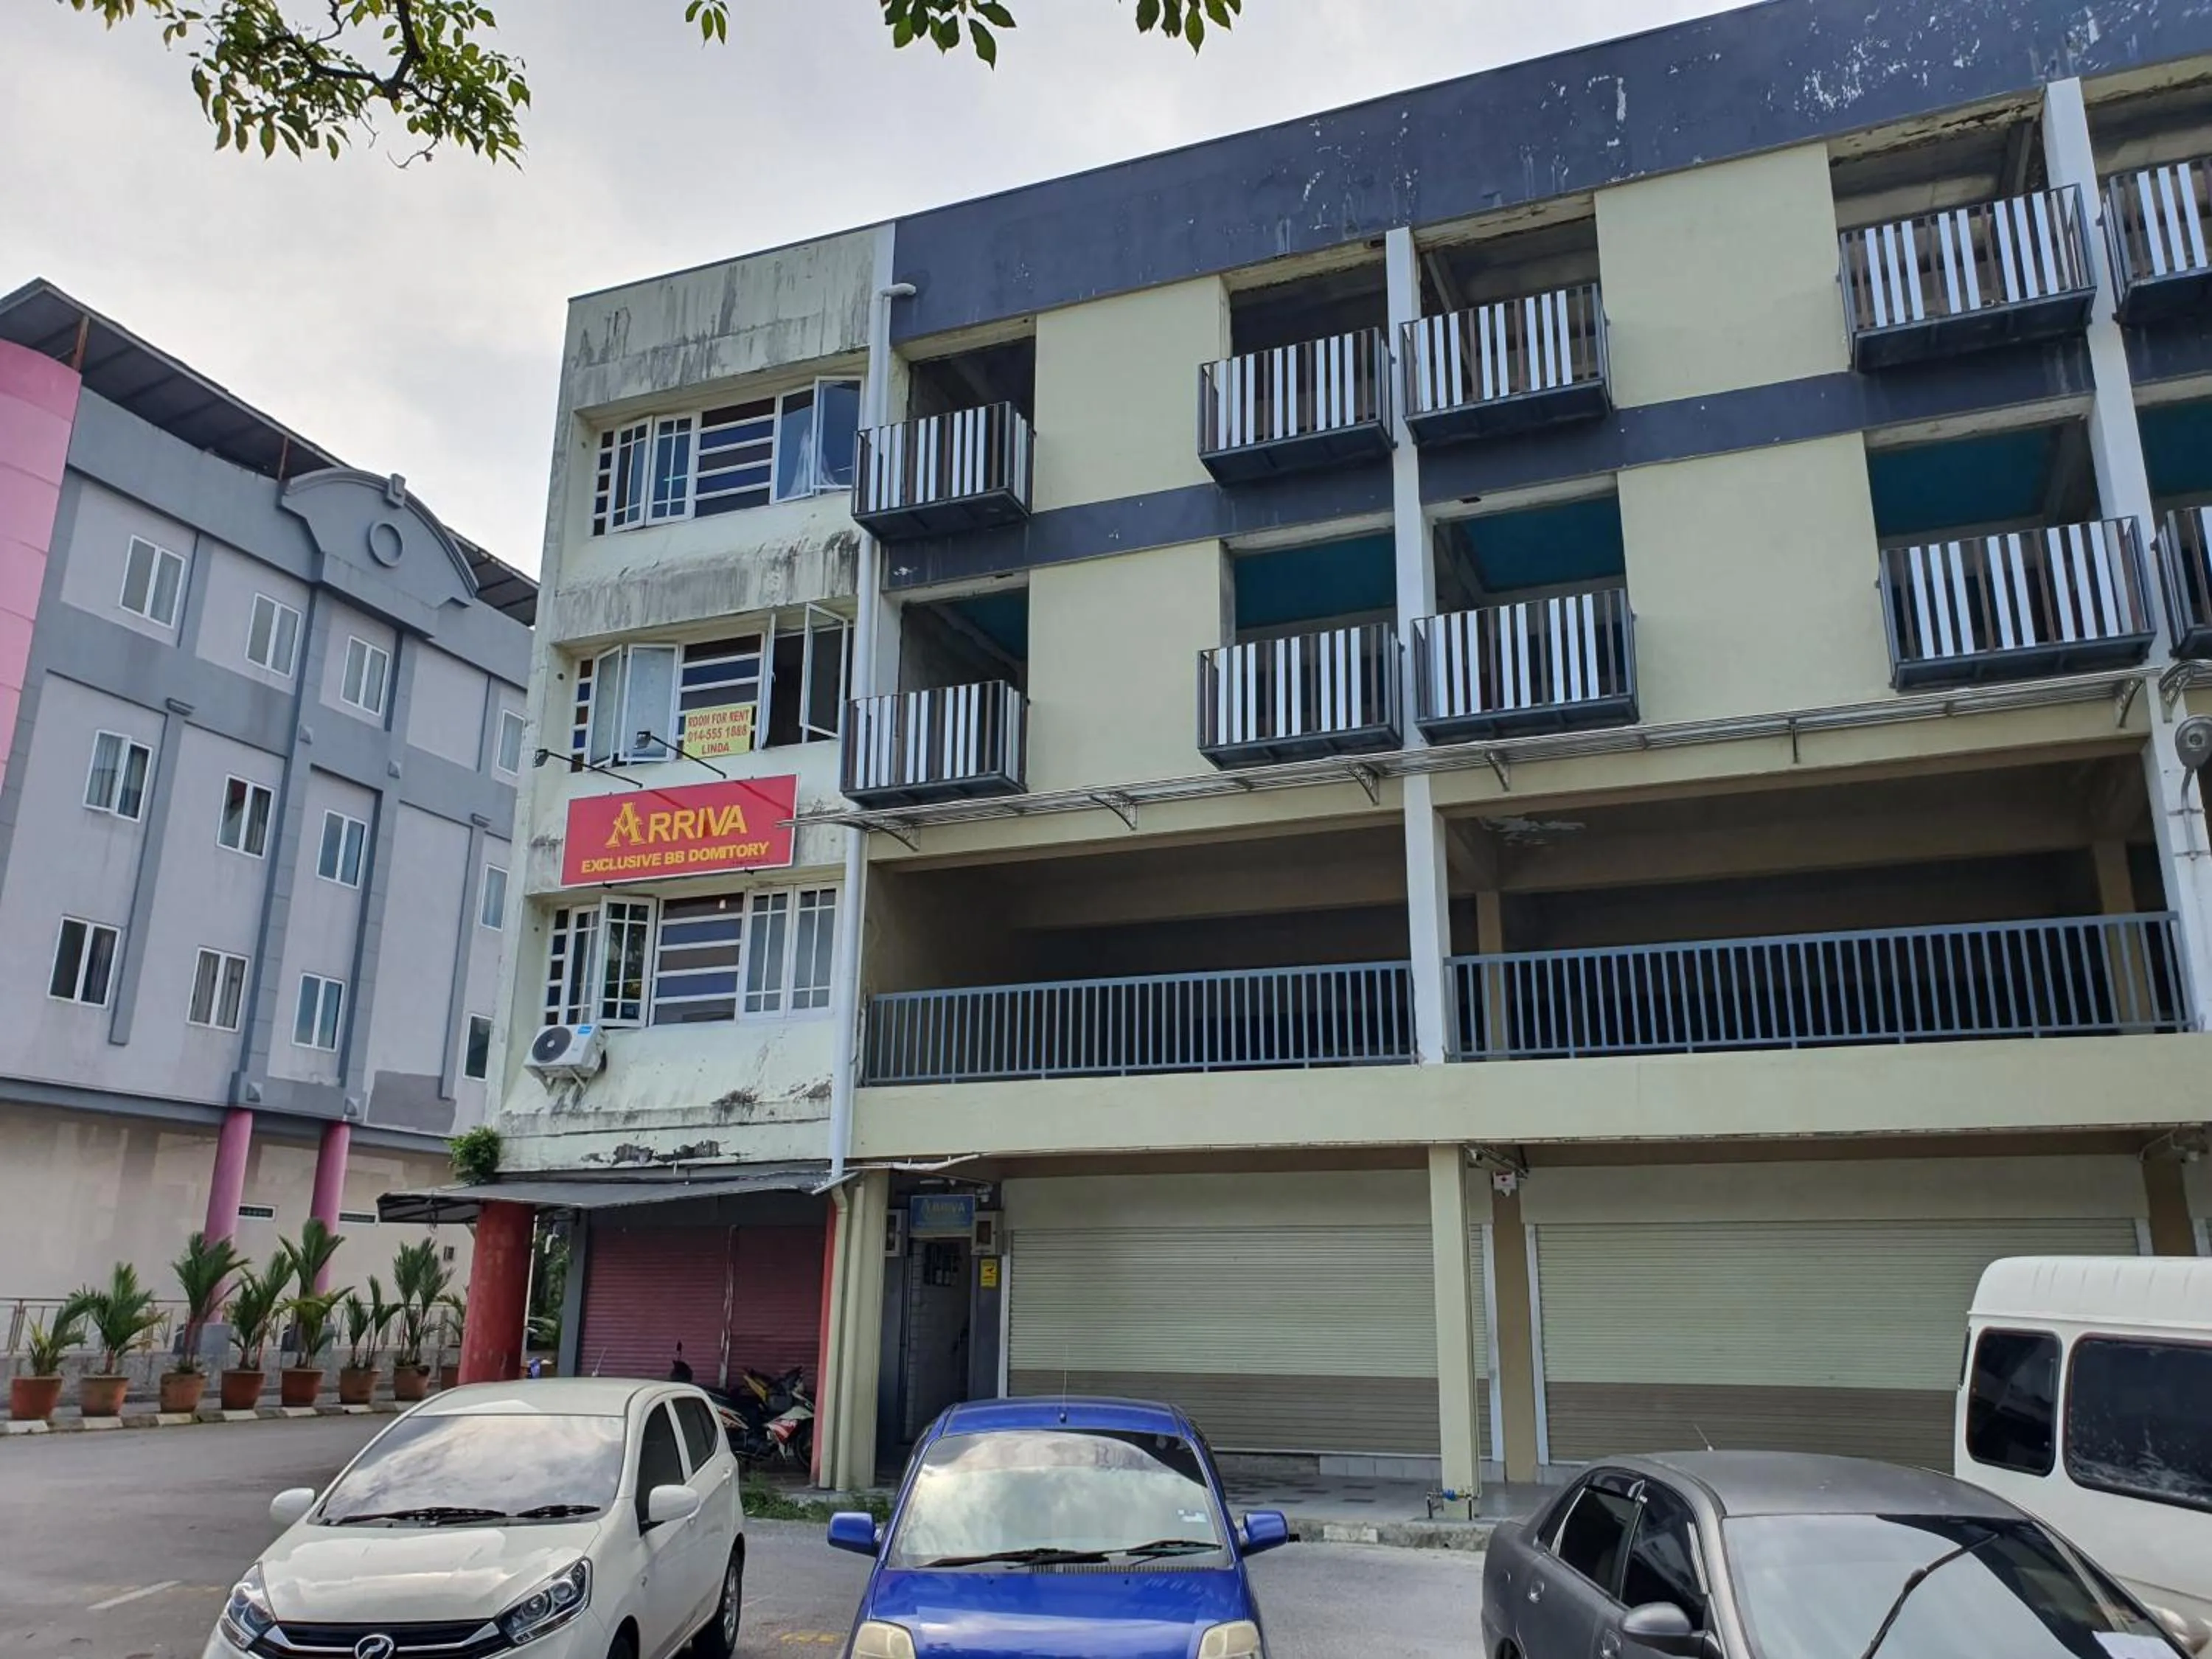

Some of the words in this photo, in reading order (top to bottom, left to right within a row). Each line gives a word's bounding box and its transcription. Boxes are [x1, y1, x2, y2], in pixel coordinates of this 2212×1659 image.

[689, 714, 710, 727] ROOM
[712, 712, 727, 723] FOR
[730, 709, 750, 722] RENT
[702, 742, 730, 755] LINDA
[605, 802, 748, 848] ARRIVA
[581, 853, 661, 874] EXCLUSIVE
[664, 850, 685, 865] BB
[689, 841, 770, 862] DOMITORY
